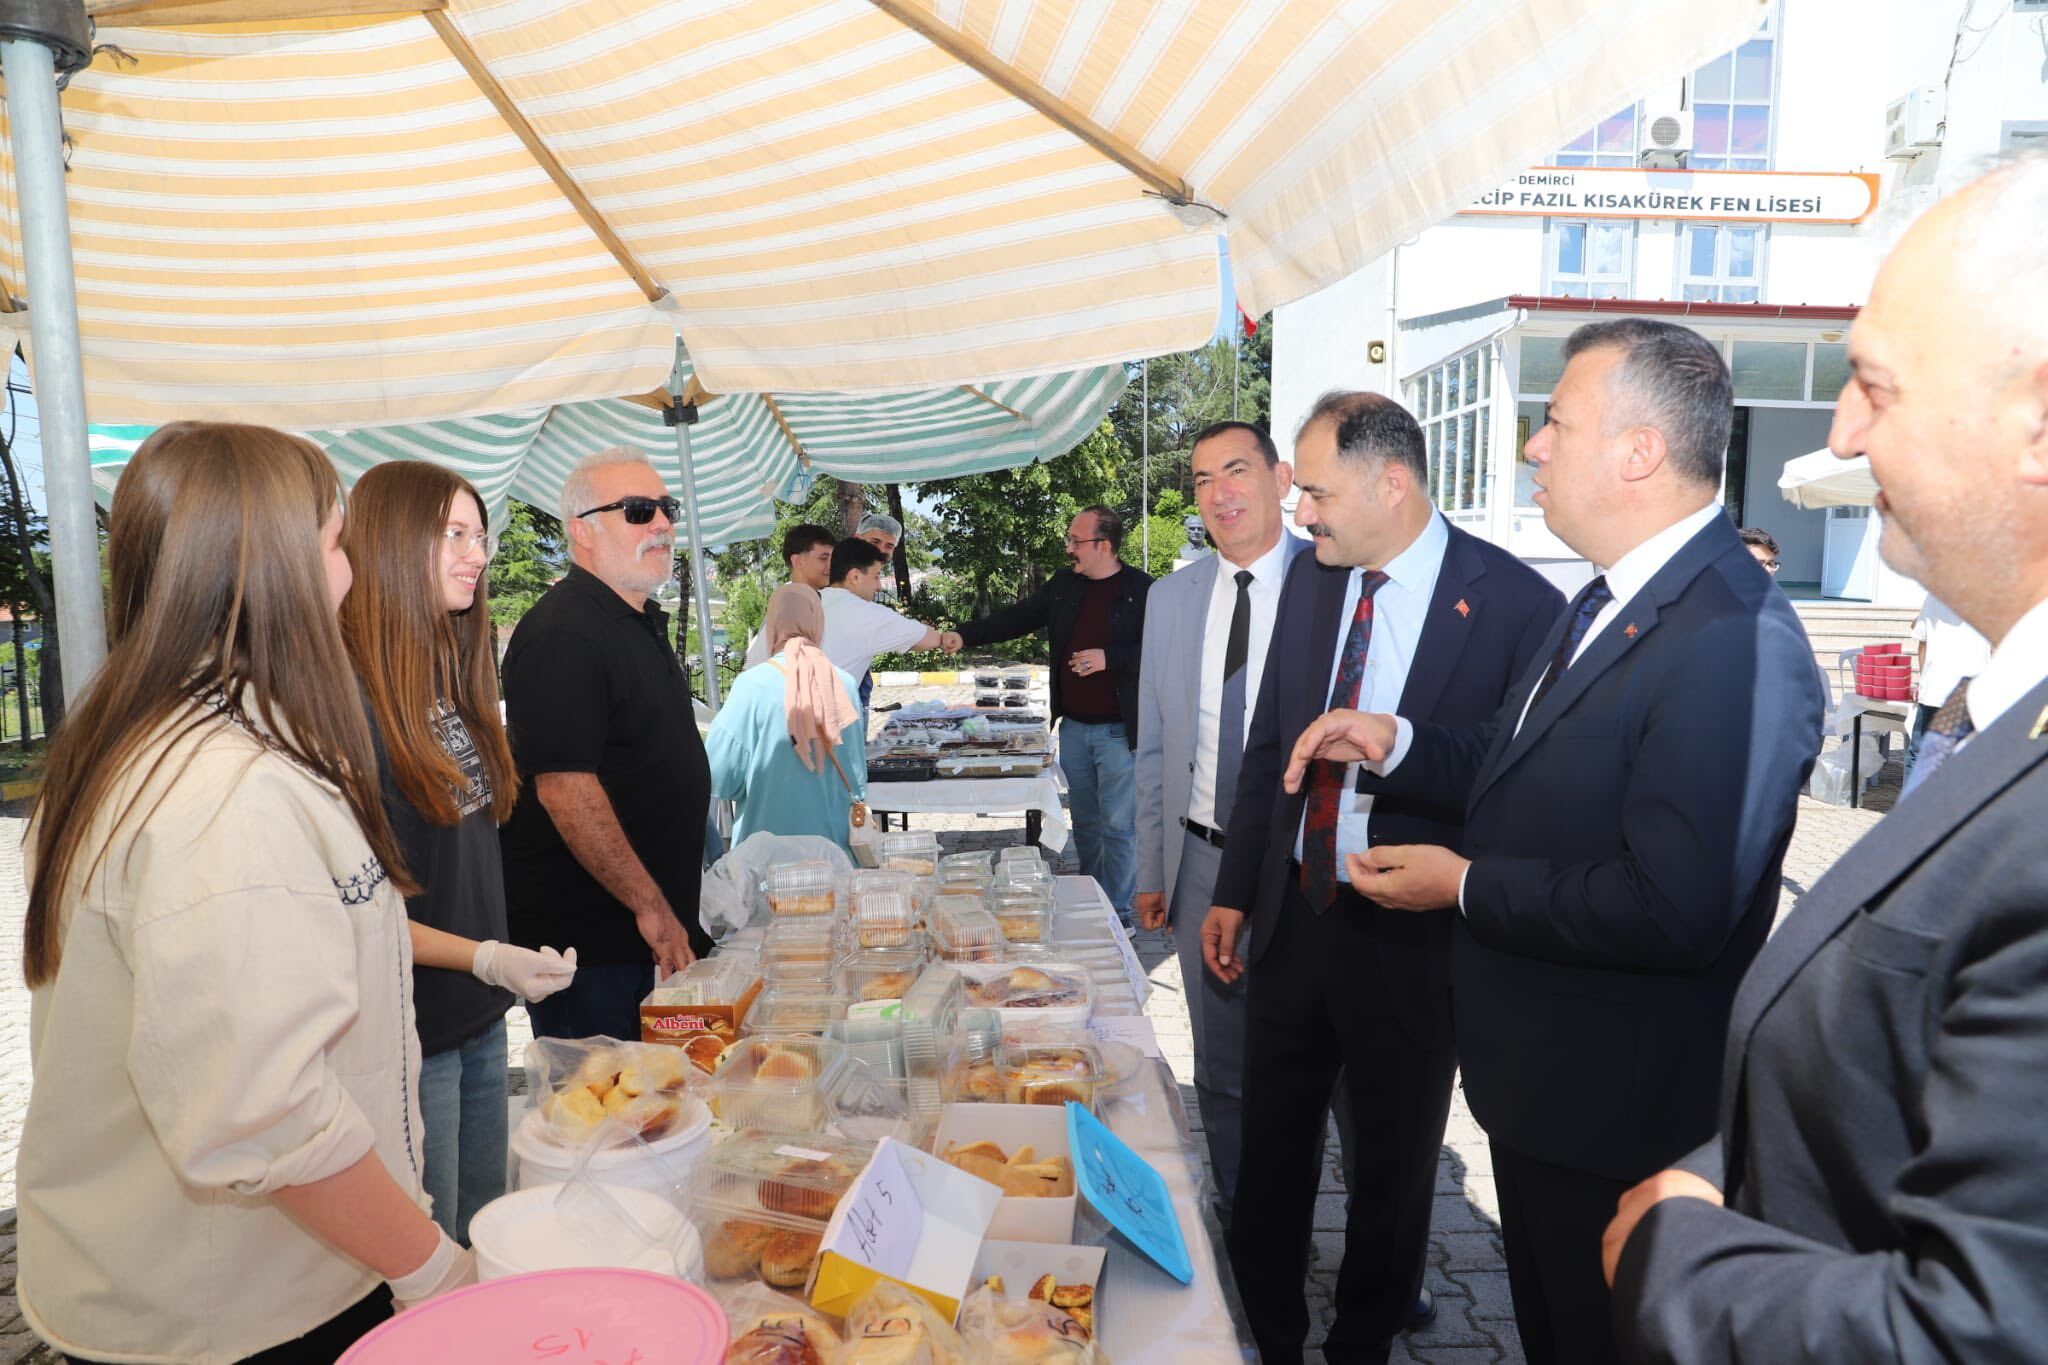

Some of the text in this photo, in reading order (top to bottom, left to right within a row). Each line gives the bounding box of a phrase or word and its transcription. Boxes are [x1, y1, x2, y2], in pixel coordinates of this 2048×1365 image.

[1519, 174, 1575, 186] DEMİRCİ
[1473, 188, 1822, 213] CİP FAZIL KISAKÜREK FEN LİSESİ
[651, 1016, 705, 1031] Albeni
